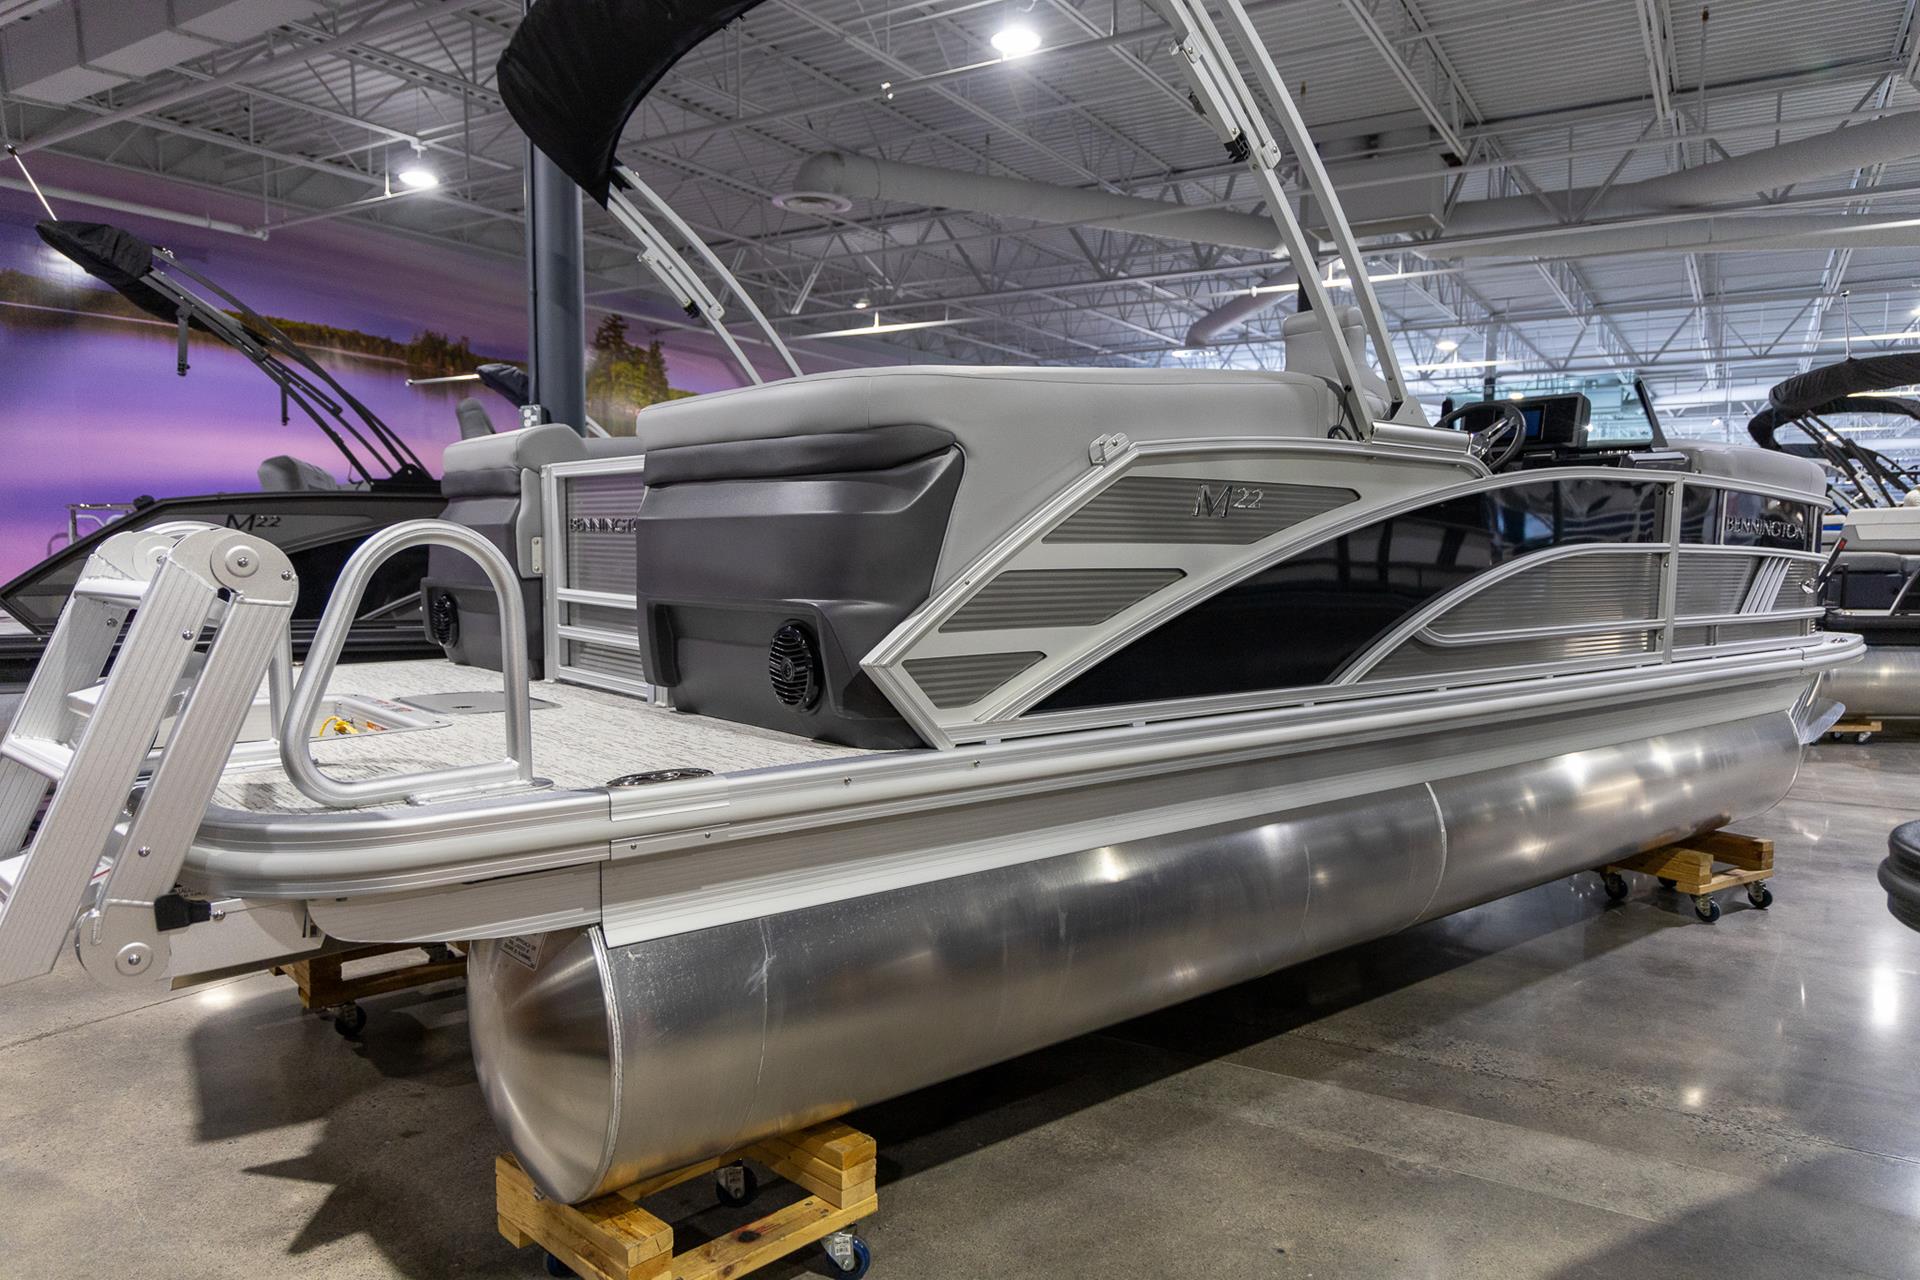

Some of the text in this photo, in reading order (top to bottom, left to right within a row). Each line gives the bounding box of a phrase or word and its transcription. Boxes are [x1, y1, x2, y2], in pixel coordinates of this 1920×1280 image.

[1192, 483, 1263, 518] M22
[225, 513, 281, 531] M22
[1726, 516, 1805, 539] BENNINGTON
